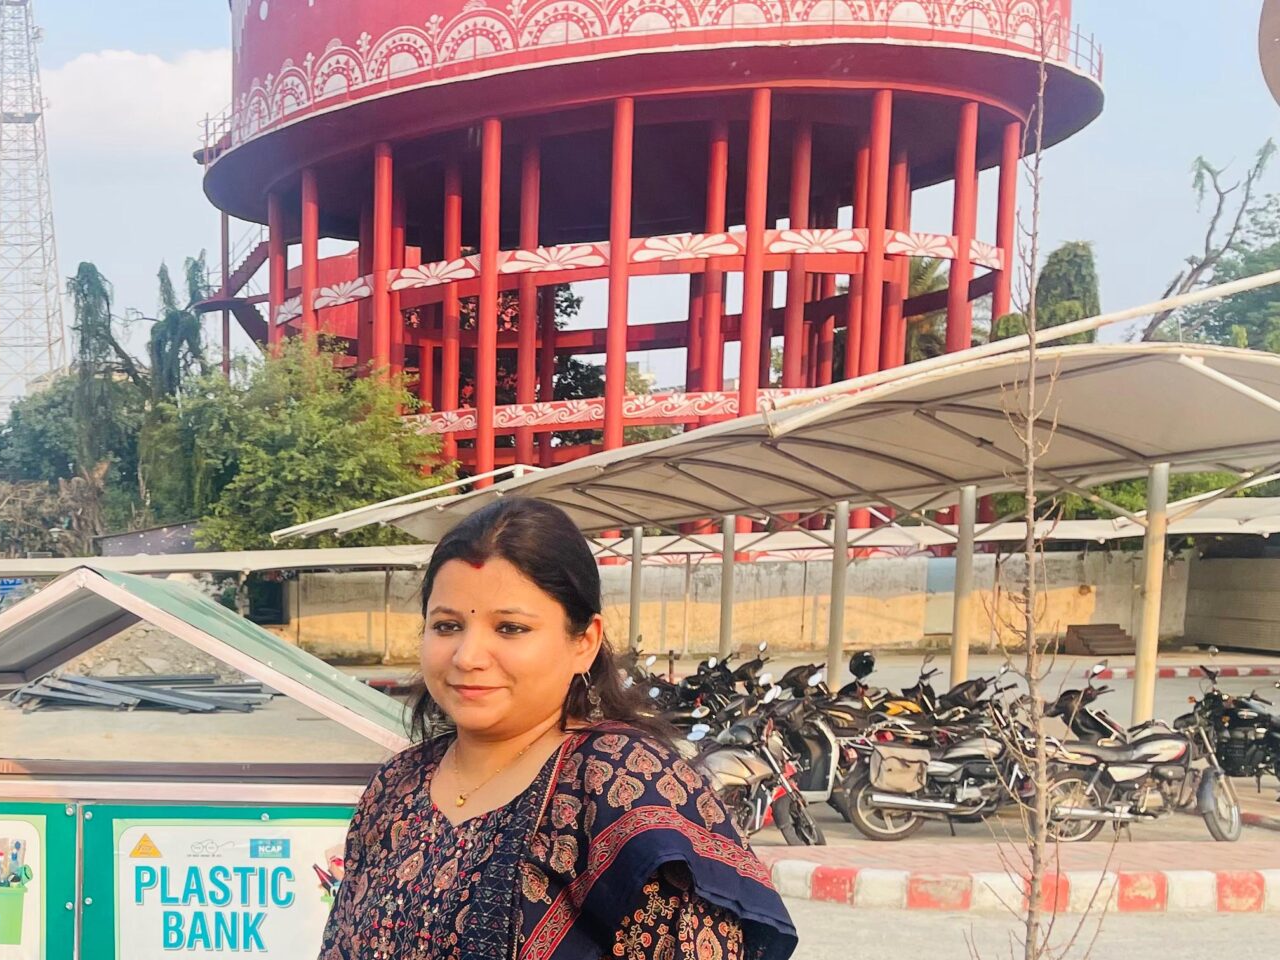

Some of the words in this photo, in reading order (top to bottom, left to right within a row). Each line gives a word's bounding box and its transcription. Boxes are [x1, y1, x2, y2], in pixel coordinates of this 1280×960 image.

[258, 845, 283, 854] NCAP
[135, 866, 295, 908] PLASTIC
[163, 911, 268, 952] BANK
